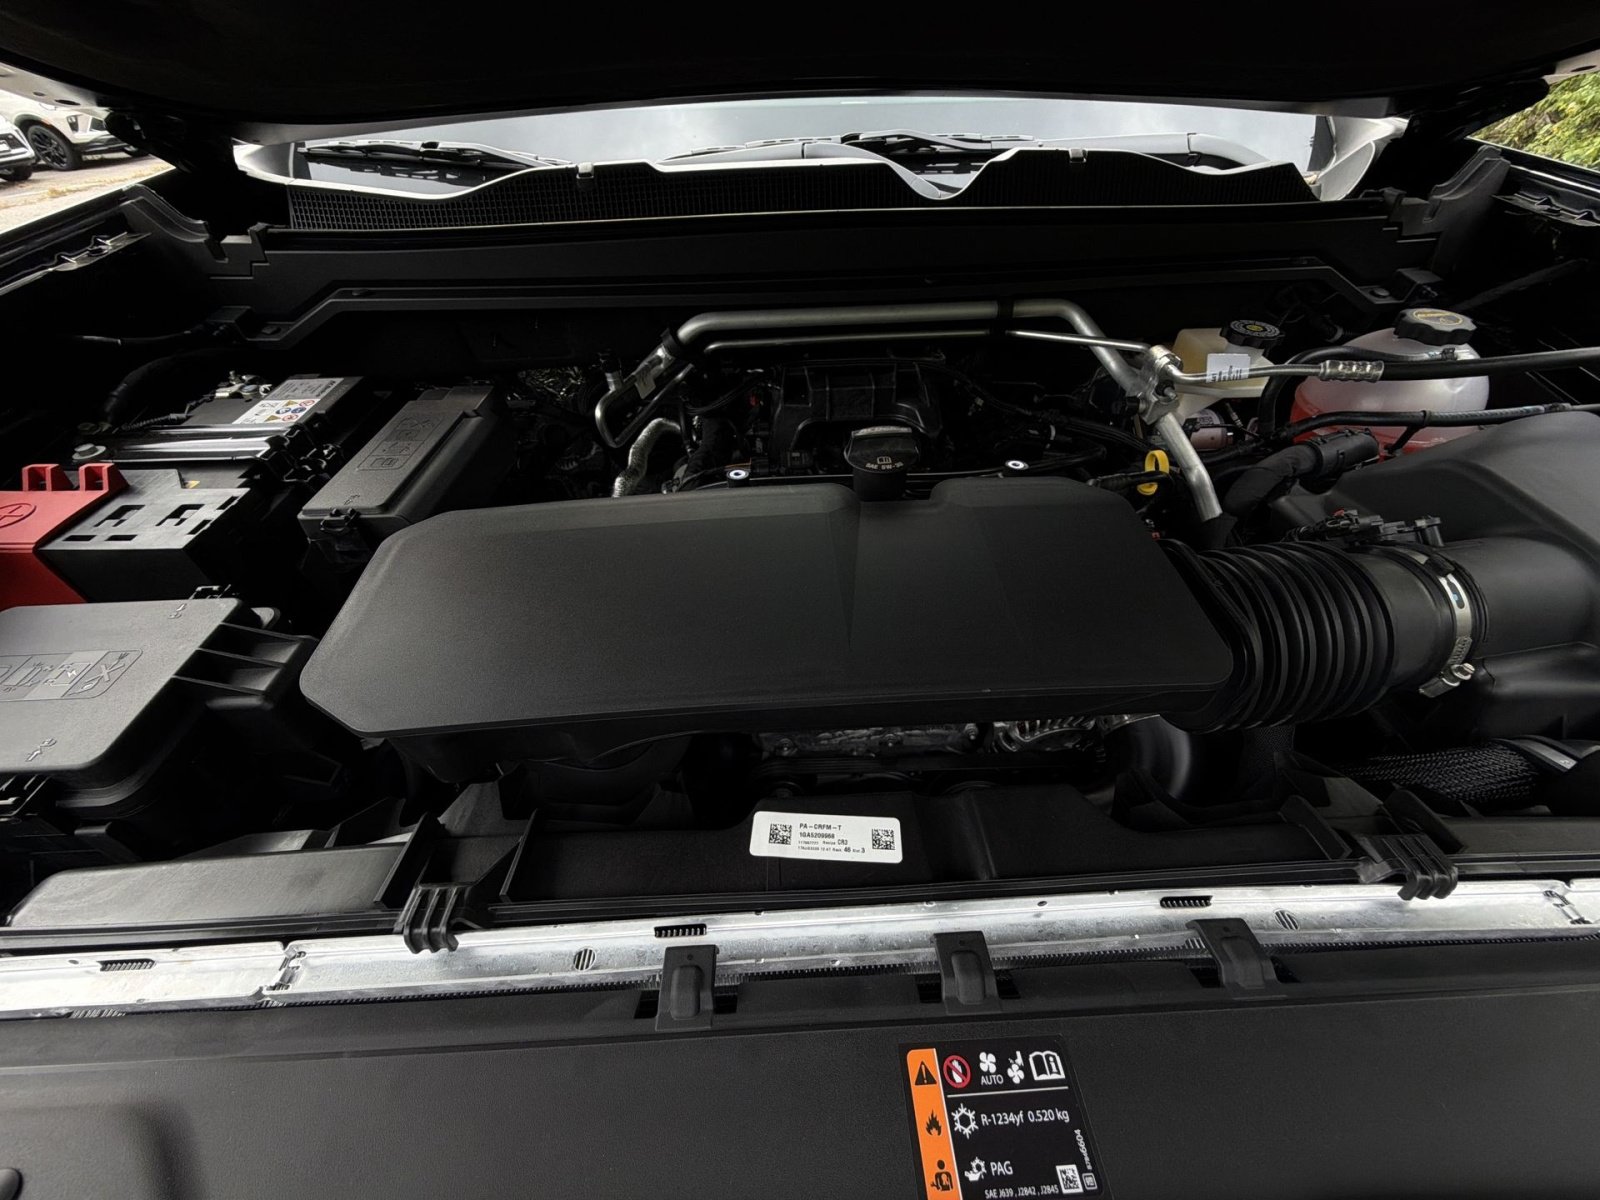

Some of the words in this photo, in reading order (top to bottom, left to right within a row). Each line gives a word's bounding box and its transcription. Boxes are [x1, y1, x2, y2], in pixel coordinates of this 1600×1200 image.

[981, 1074, 1004, 1086] AUTO
[981, 1110, 1025, 1127] R-1234yf
[1028, 1109, 1055, 1123] 0.520
[1055, 1107, 1070, 1123] kg
[990, 1161, 1013, 1176] PAG
[984, 1188, 998, 1199] SAE
[1040, 1184, 1059, 1195] J2845
